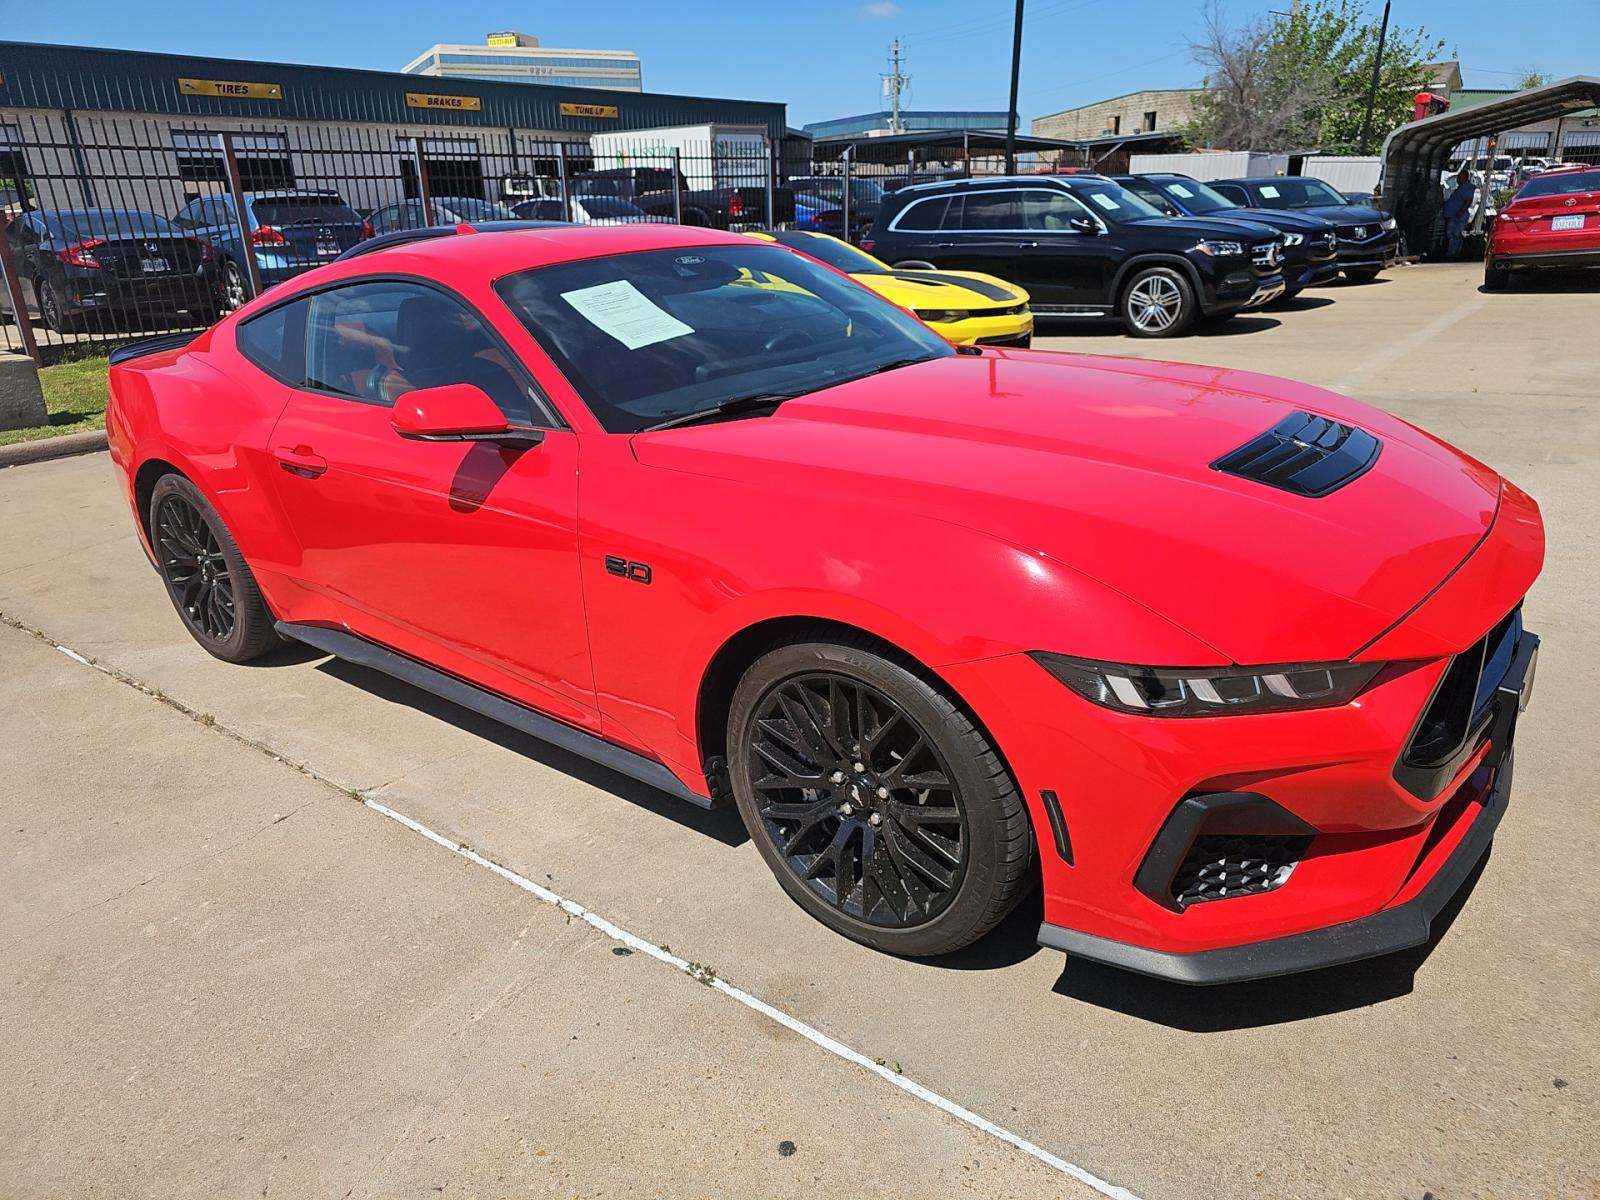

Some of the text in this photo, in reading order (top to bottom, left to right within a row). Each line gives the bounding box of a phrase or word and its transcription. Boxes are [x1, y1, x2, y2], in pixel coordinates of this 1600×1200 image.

[215, 83, 249, 95] TIRES
[427, 97, 462, 107] BRAKES
[575, 106, 594, 115] TUNE
